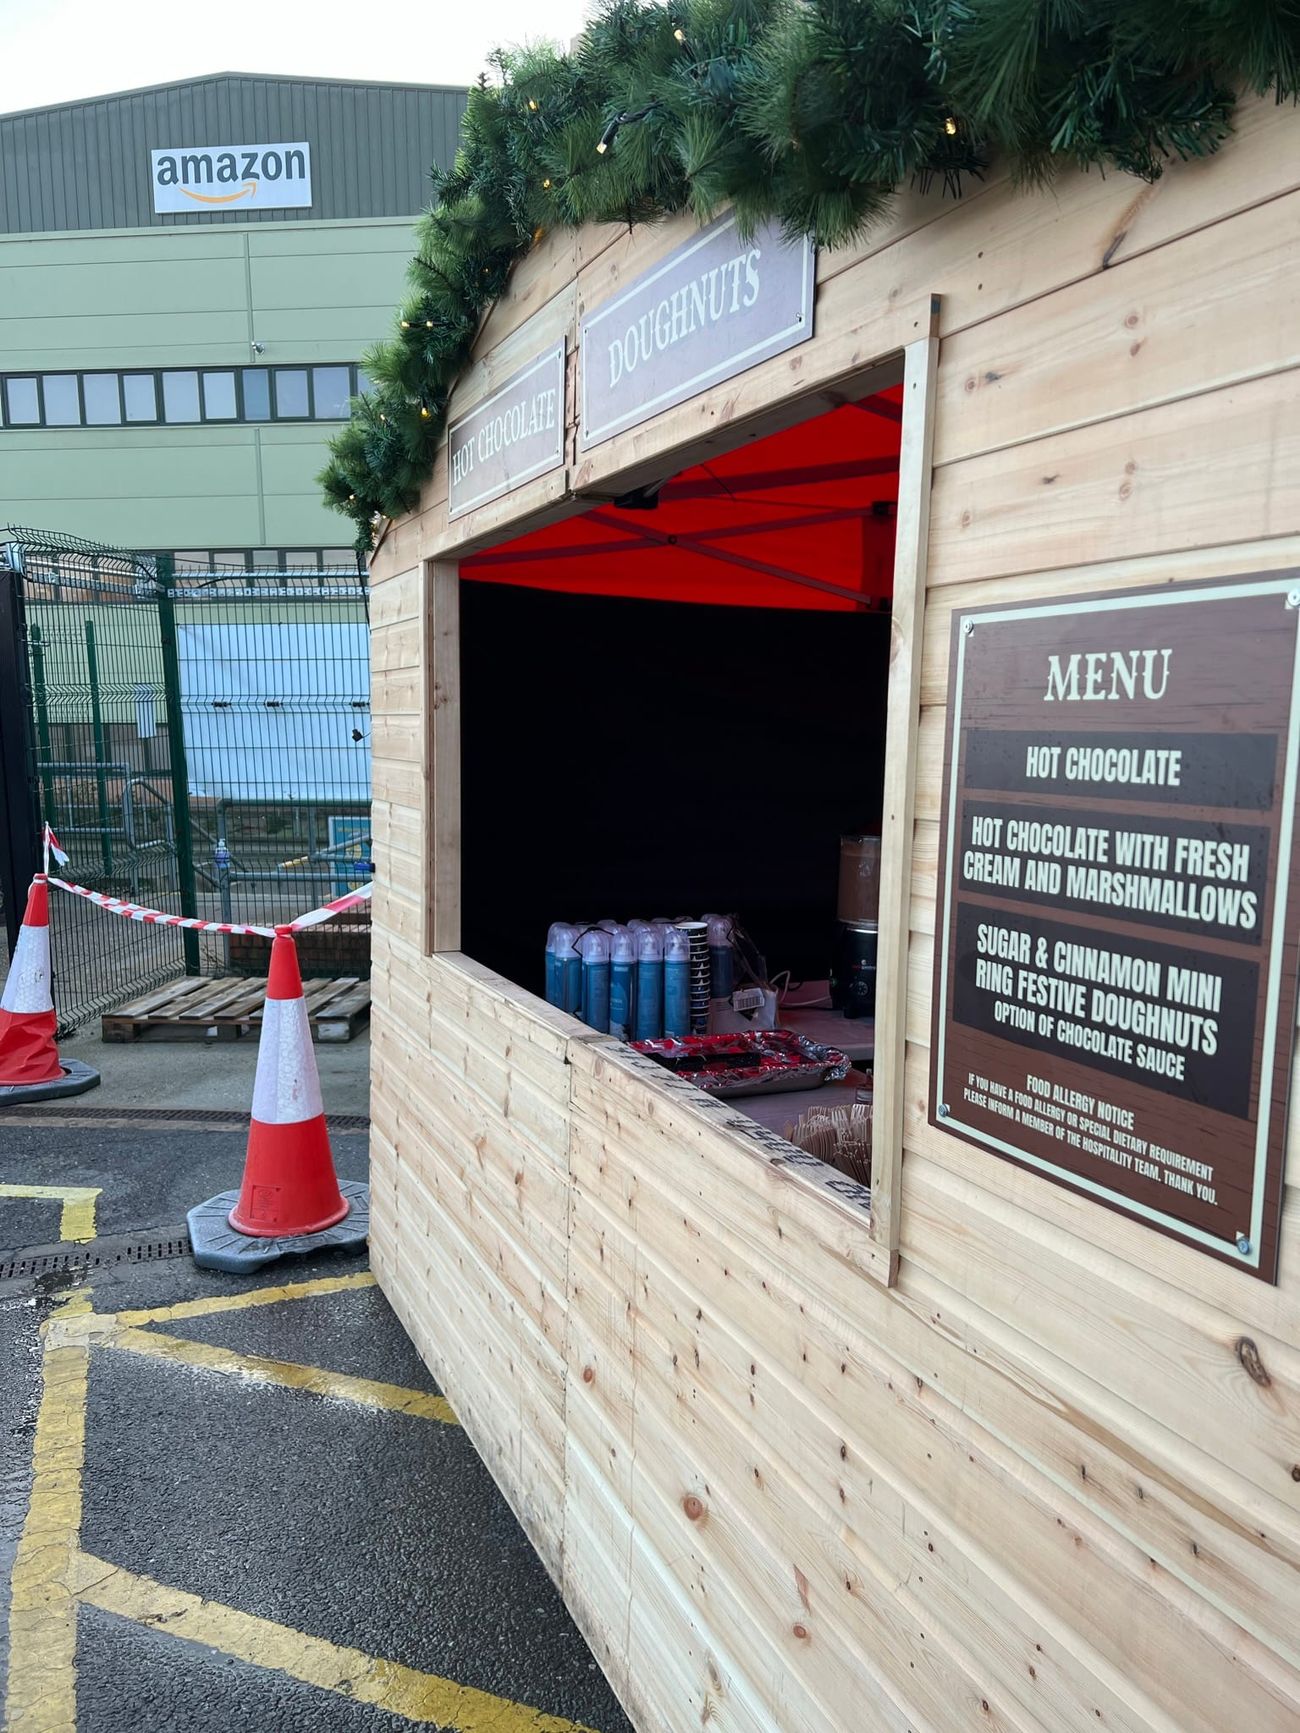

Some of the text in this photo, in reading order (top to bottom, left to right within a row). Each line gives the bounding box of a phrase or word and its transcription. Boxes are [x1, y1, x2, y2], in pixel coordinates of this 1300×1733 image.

[157, 150, 306, 185] amazon
[608, 249, 761, 388] DOUGHNUTS
[453, 389, 555, 486] HOT CHOCOLATE
[1044, 649, 1173, 701] MENU
[1025, 746, 1182, 786] HOT CHOCOLATE
[971, 815, 1250, 883] HOT CHOCOLATE WITH FRESH
[963, 851, 1257, 930] CREAM AND MARSHMALLOWS
[975, 958, 1218, 1055] RING FESTIVE DOUGHNUTS
[977, 924, 1222, 1013] SUGAR & CINNAMON MINI
[994, 1001, 1186, 1081] OPTION OF CHOCOLATE SAUCE
[968, 1072, 1214, 1182] IF YOU HAVE A FOOD ALLERGY OR SPECIAL DIETARY REQUIREMENT
[1026, 1074, 1135, 1131] FOOD ALLERGY NOTICE
[964, 1087, 1218, 1205] PLEASE INFORM A MEMBER OF THE HOSPITALITY TEAM. THANK YOU.
